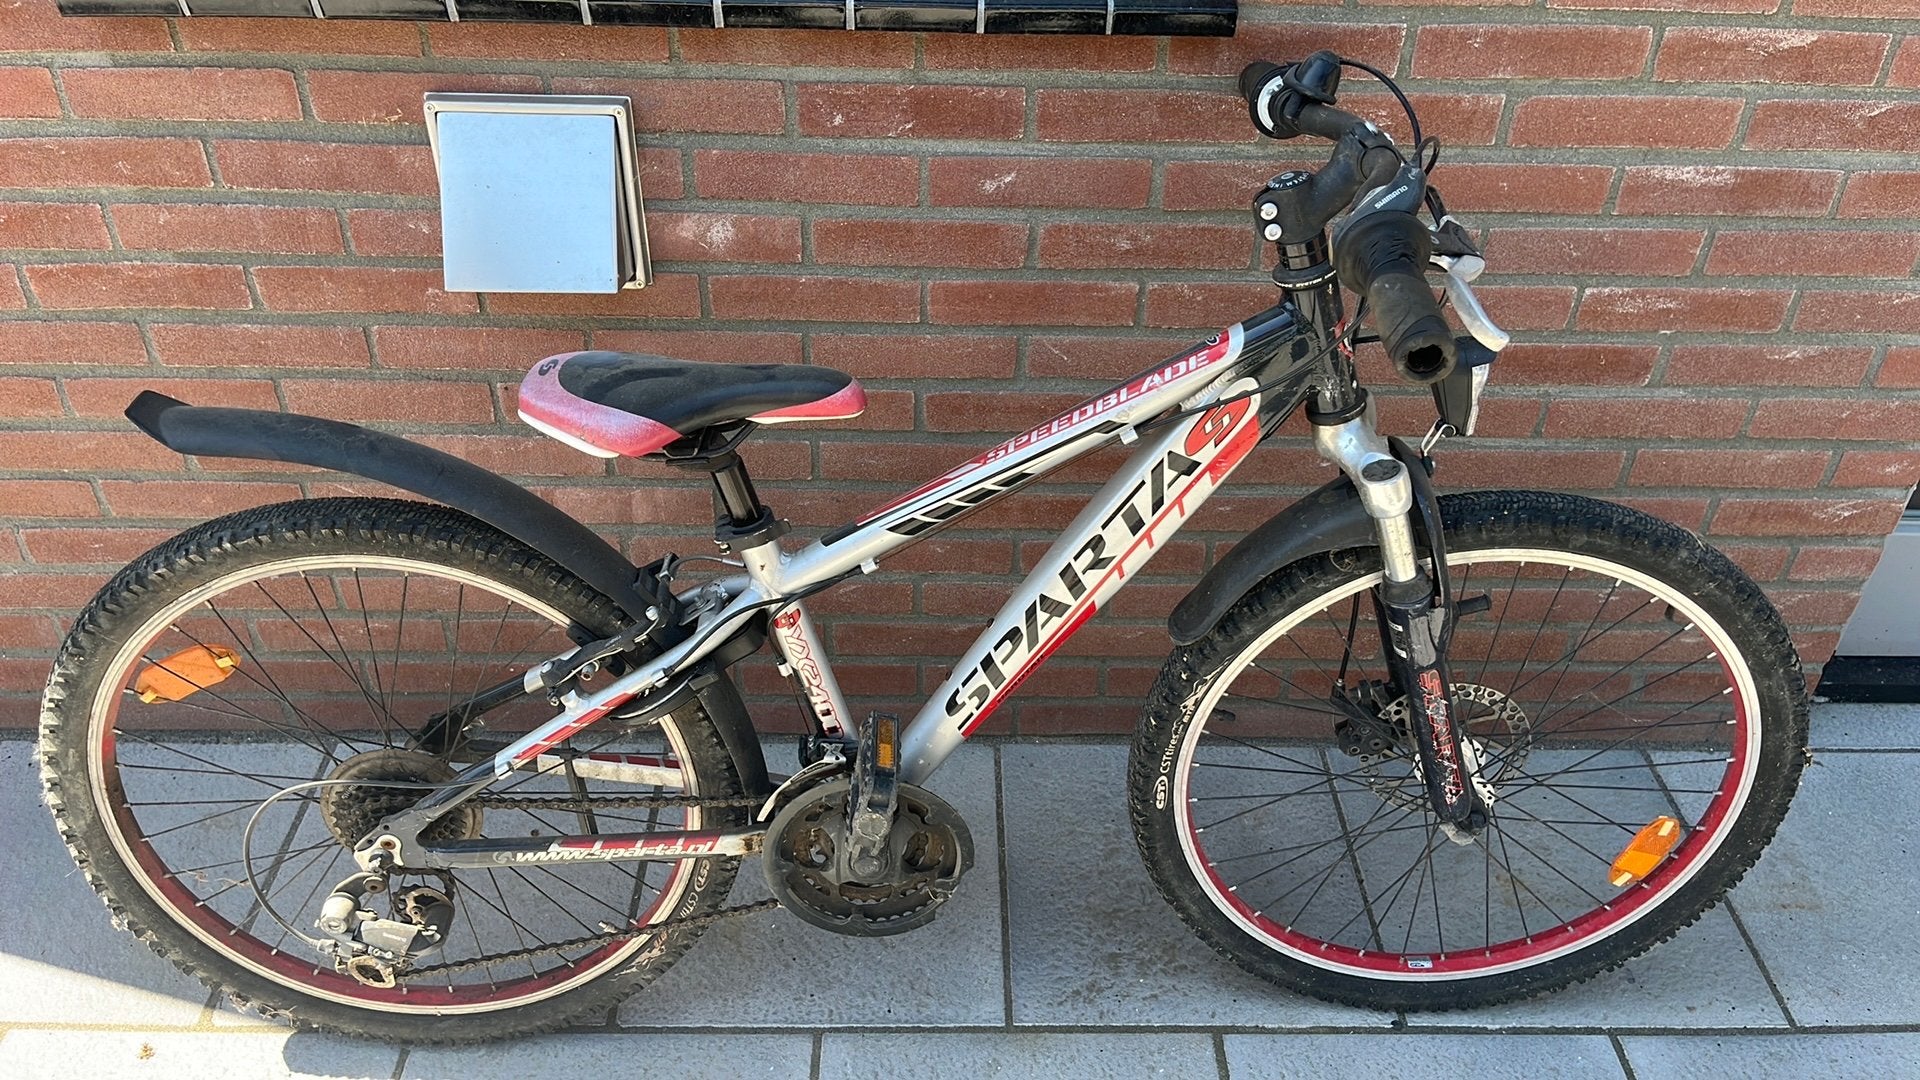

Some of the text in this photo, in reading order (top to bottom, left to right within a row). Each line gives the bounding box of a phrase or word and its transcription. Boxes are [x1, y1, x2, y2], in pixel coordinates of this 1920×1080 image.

[1374, 185, 1409, 209] SHIMANO
[985, 349, 1210, 464] SPEEDBLADE
[945, 449, 1202, 730] SPARTA
